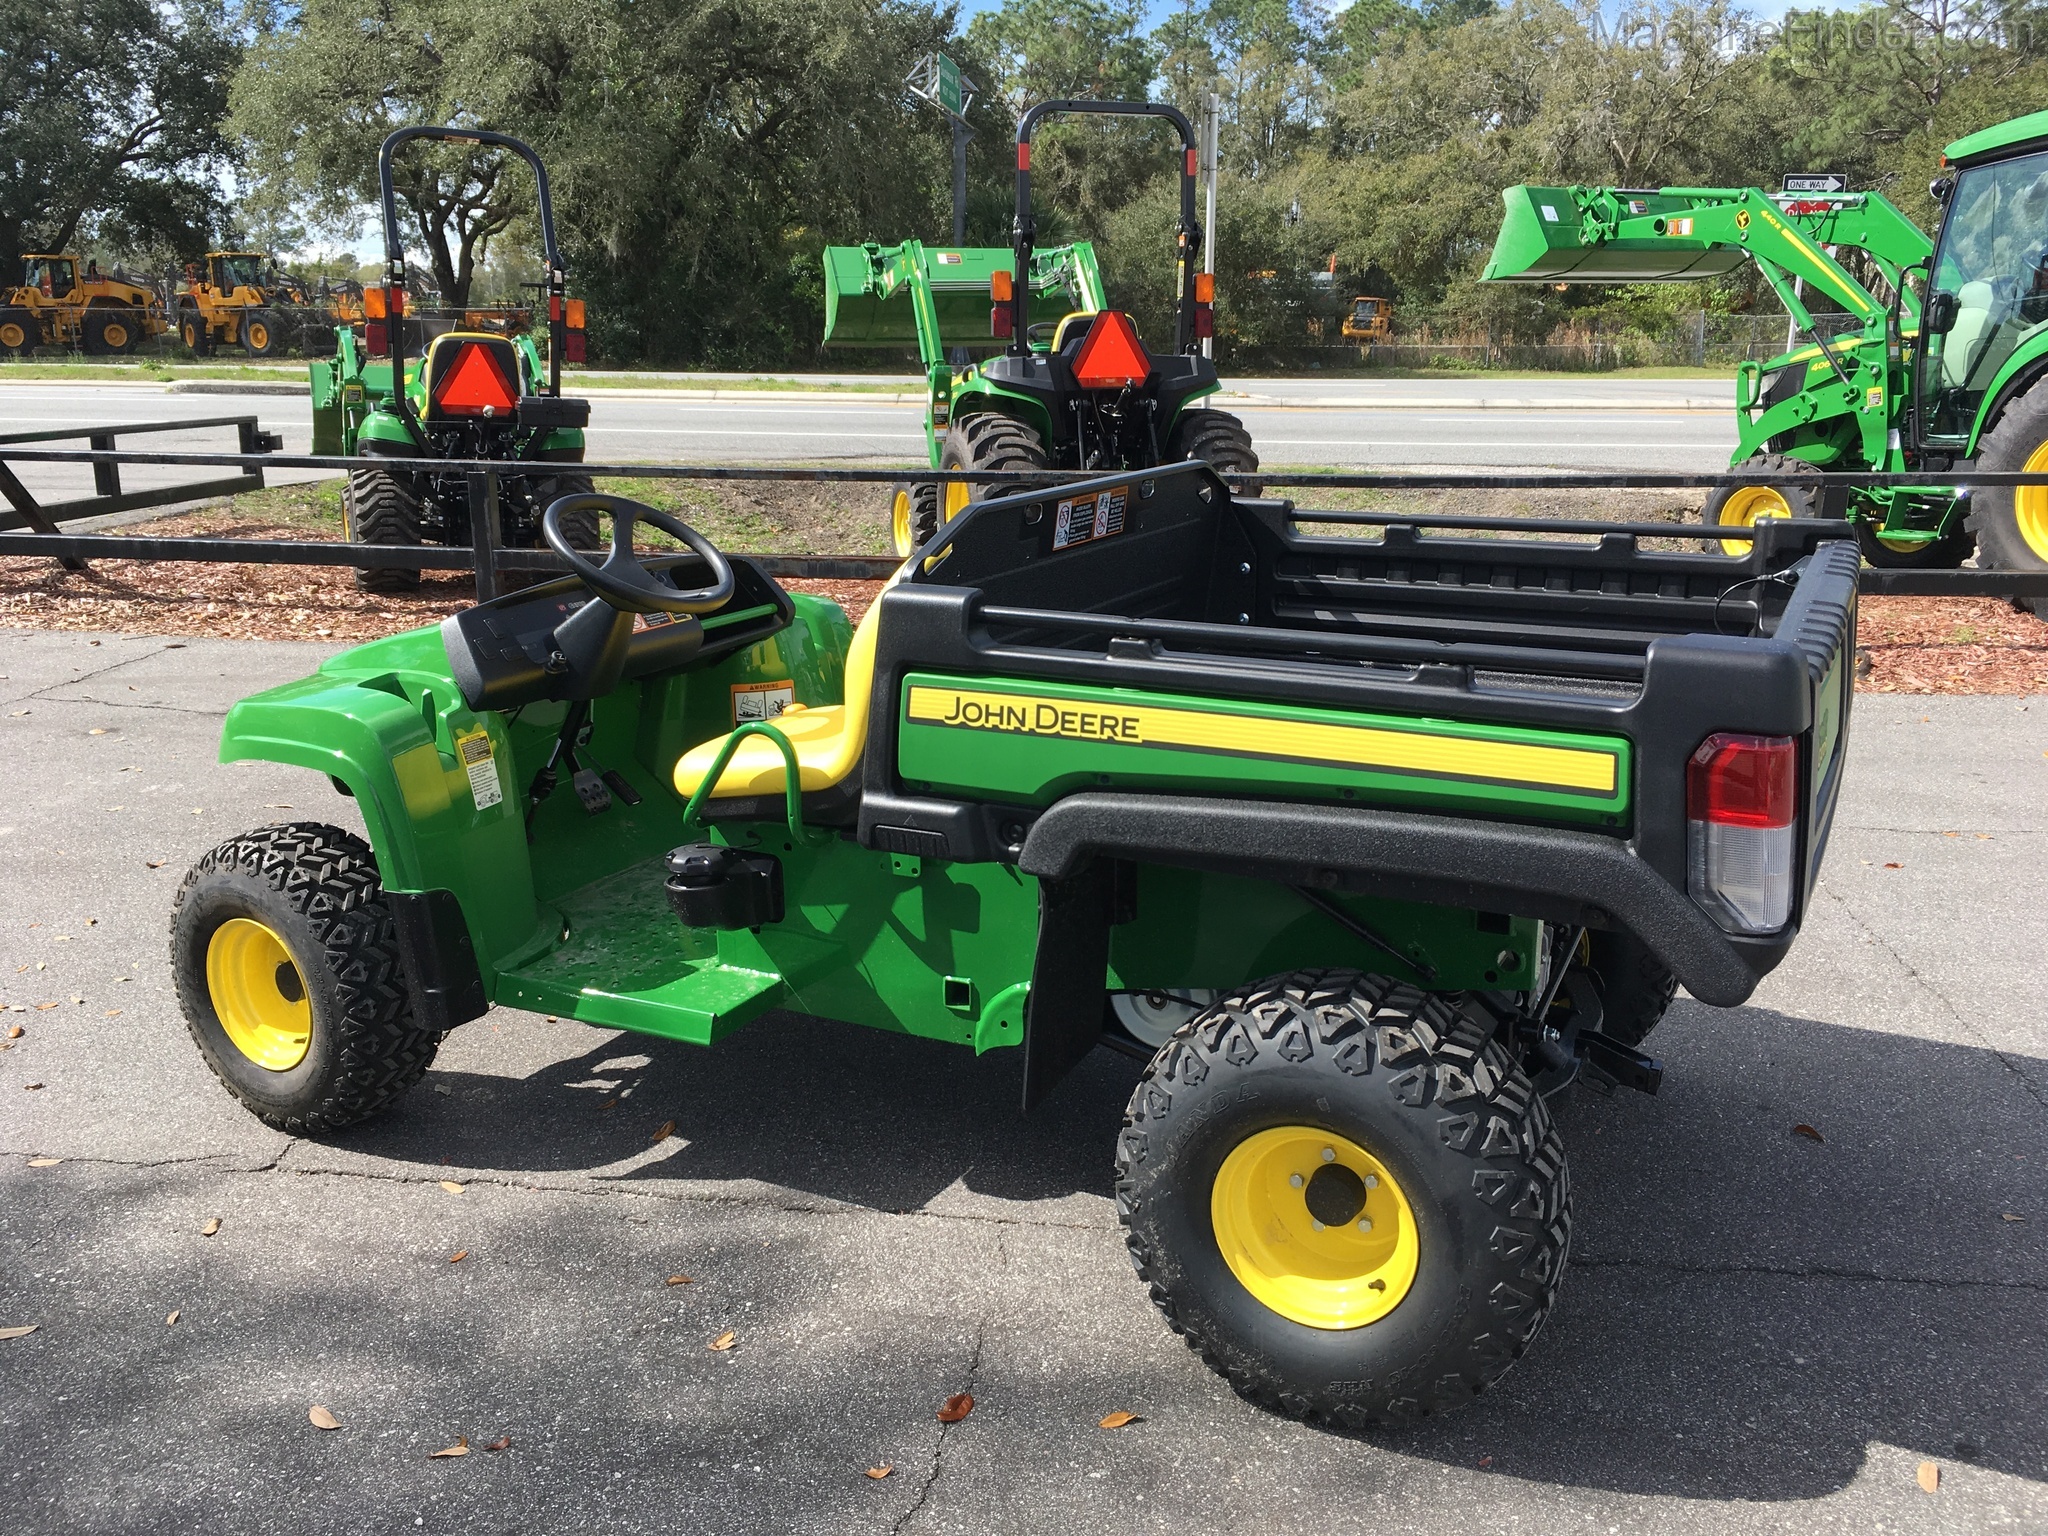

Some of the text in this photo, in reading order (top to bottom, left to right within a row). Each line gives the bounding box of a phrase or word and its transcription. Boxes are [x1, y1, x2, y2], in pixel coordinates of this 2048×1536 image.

[1790, 181, 1827, 189] ONE WAY
[944, 696, 1140, 739] JOHN DEERE
